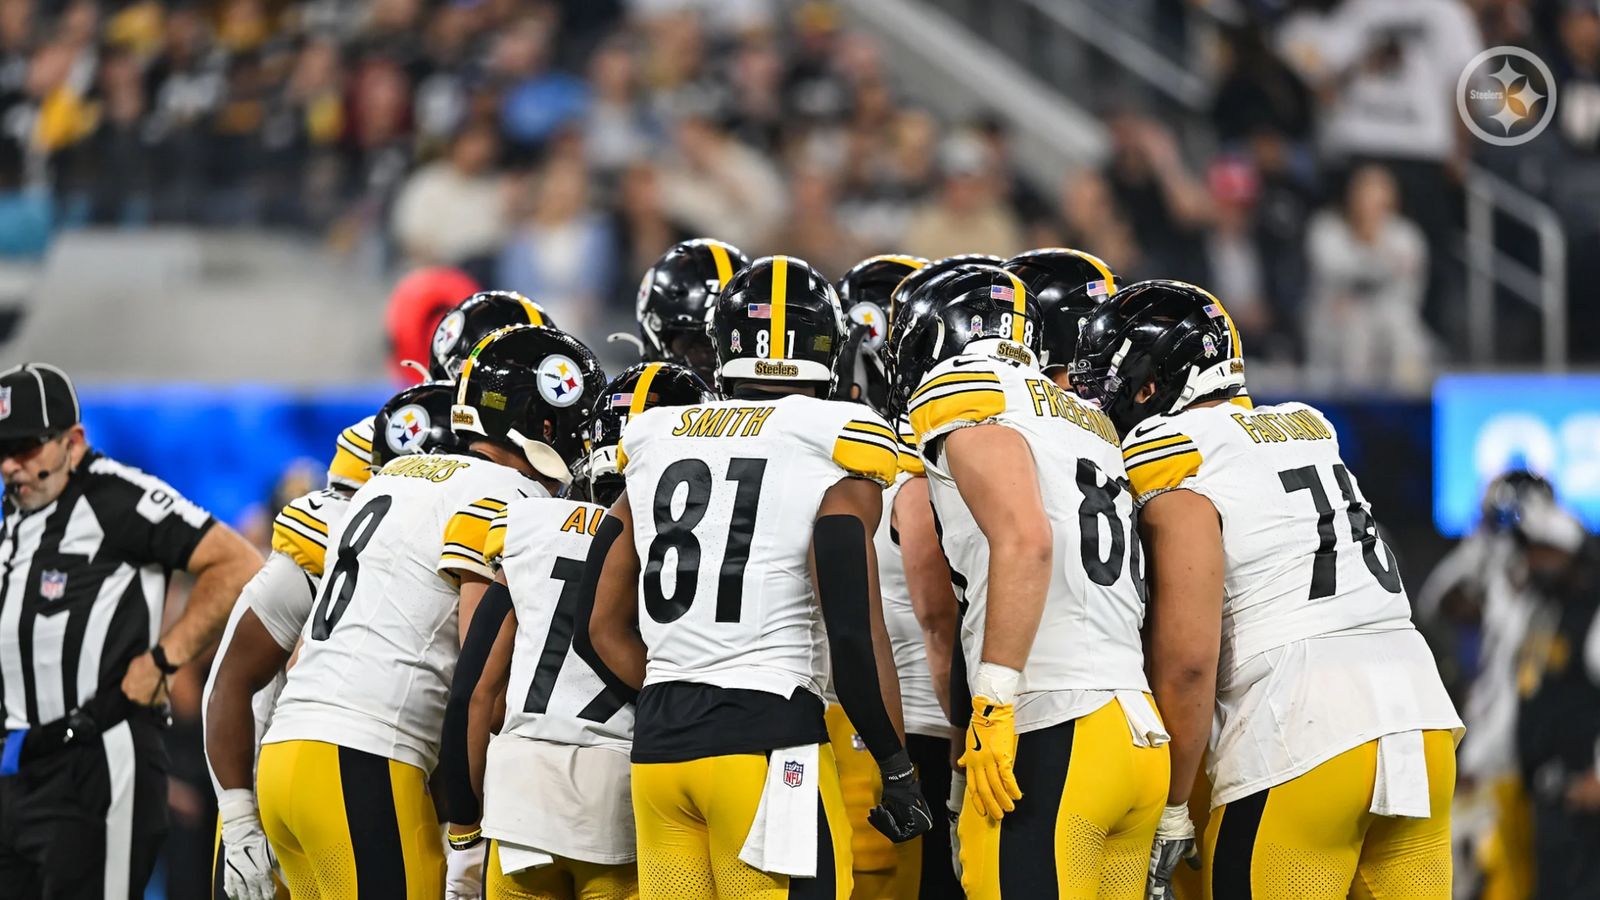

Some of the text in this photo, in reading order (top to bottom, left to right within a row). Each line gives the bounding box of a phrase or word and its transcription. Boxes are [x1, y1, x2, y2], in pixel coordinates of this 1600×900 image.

[756, 329, 796, 359] 81
[998, 312, 1034, 348] 88
[755, 360, 799, 377] Steelers
[996, 341, 1032, 367] Steelers
[671, 406, 776, 438] SMITH
[643, 457, 768, 624] 81
[311, 494, 392, 642] 8
